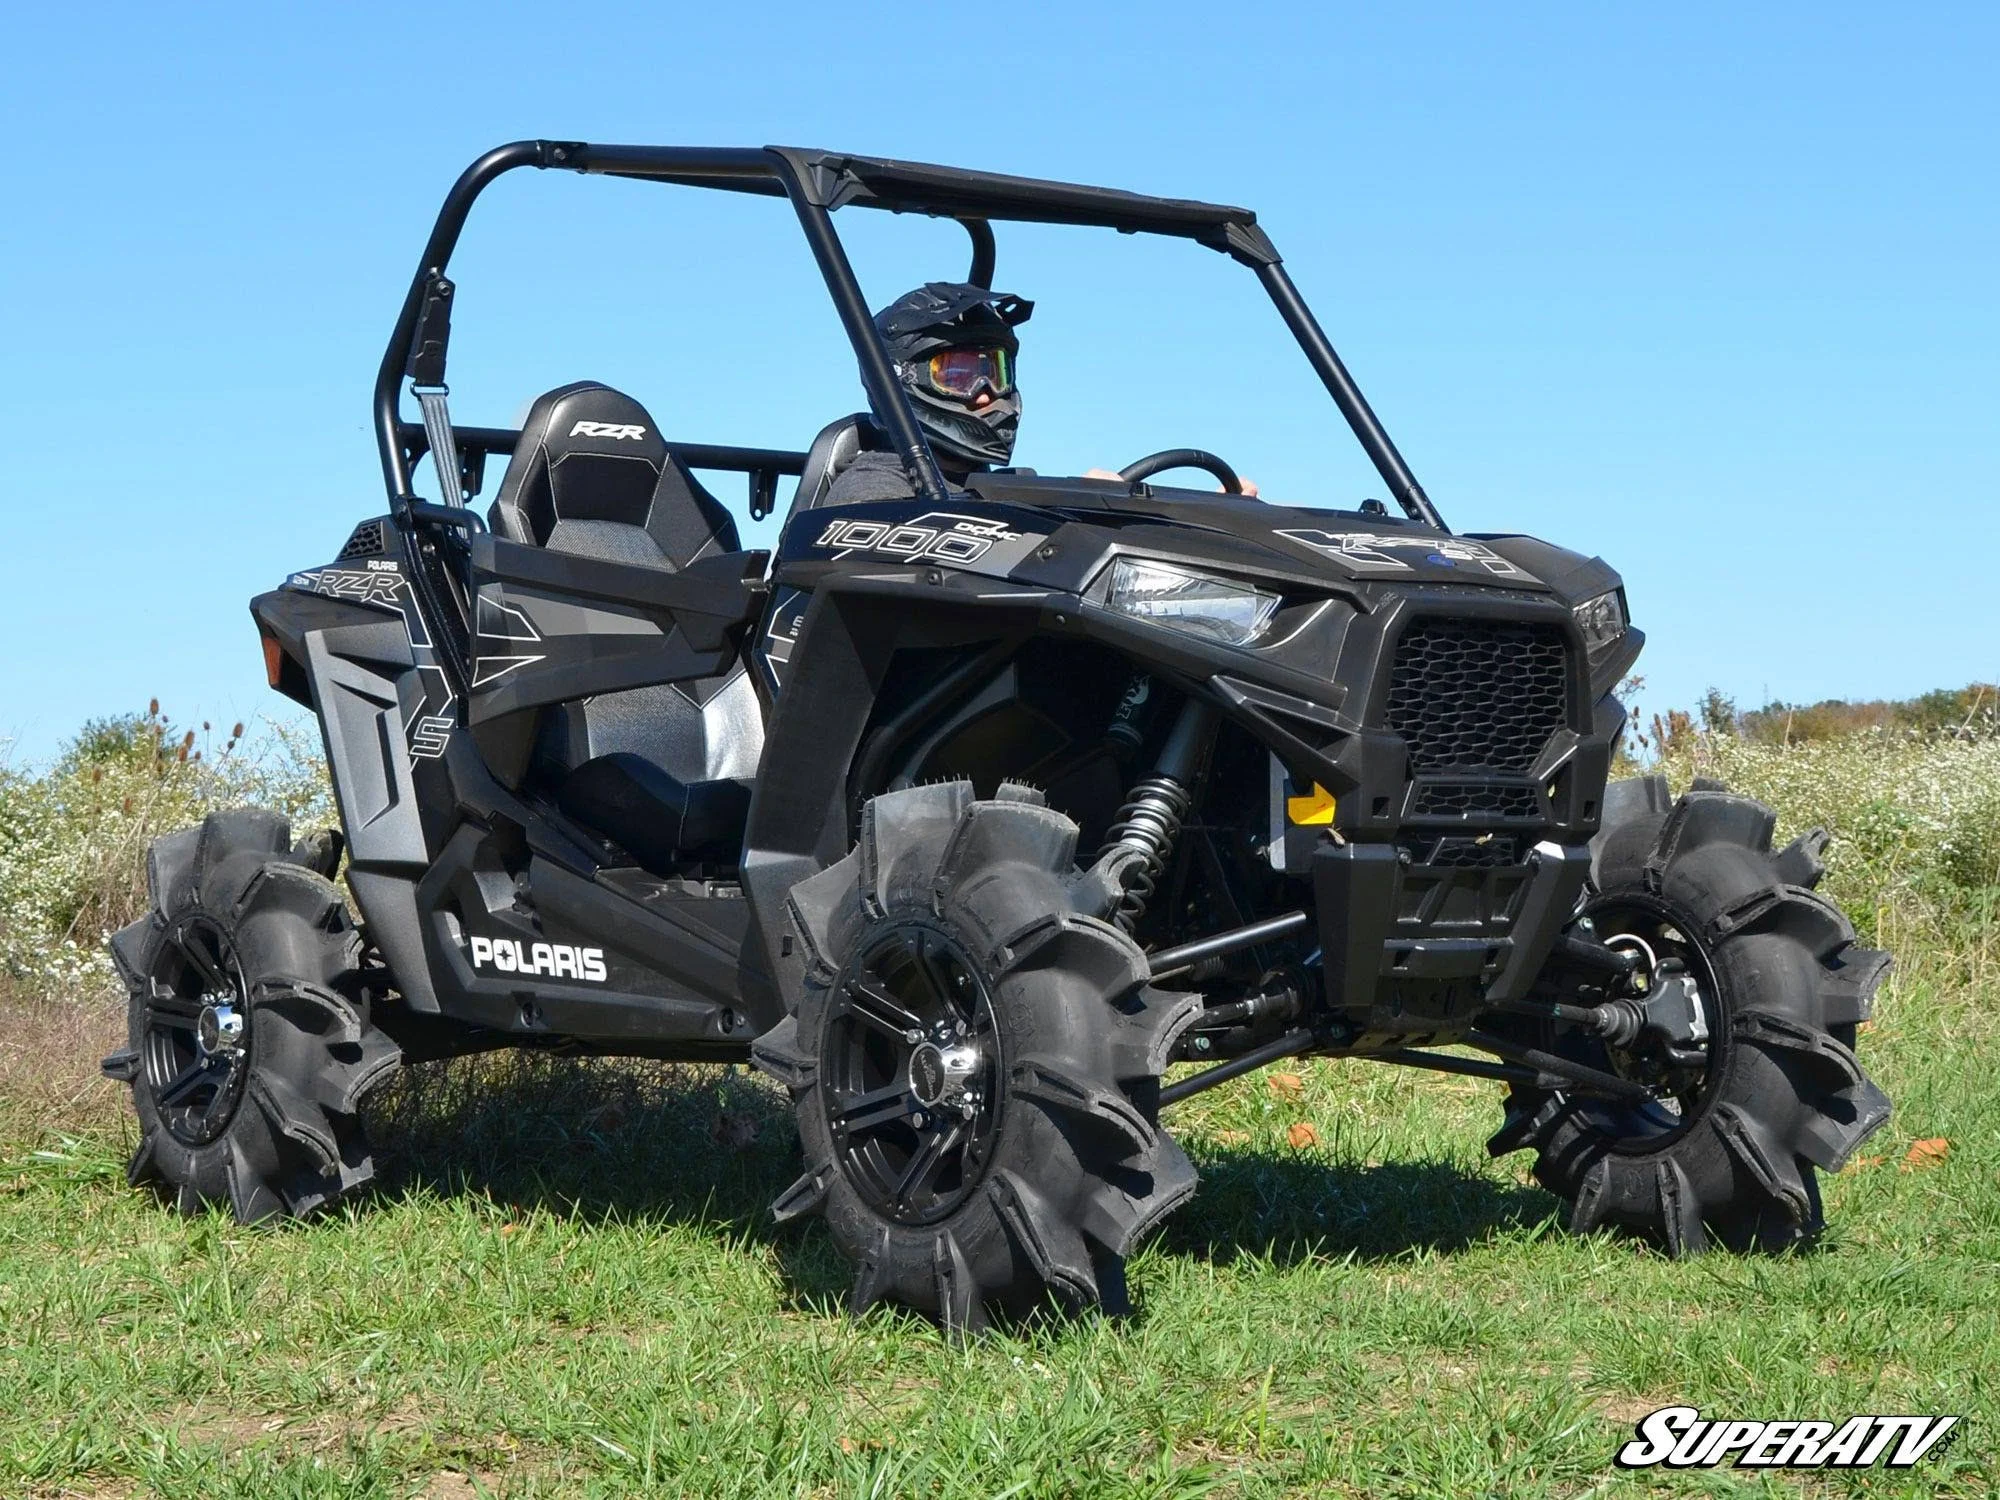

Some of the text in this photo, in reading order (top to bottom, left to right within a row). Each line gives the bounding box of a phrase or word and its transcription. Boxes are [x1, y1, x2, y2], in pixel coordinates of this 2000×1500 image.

[569, 421, 645, 441] RZR
[815, 519, 994, 565] 1000
[367, 560, 398, 571] POLARIS
[313, 569, 406, 602] RZR
[470, 935, 608, 983] POLARIS
